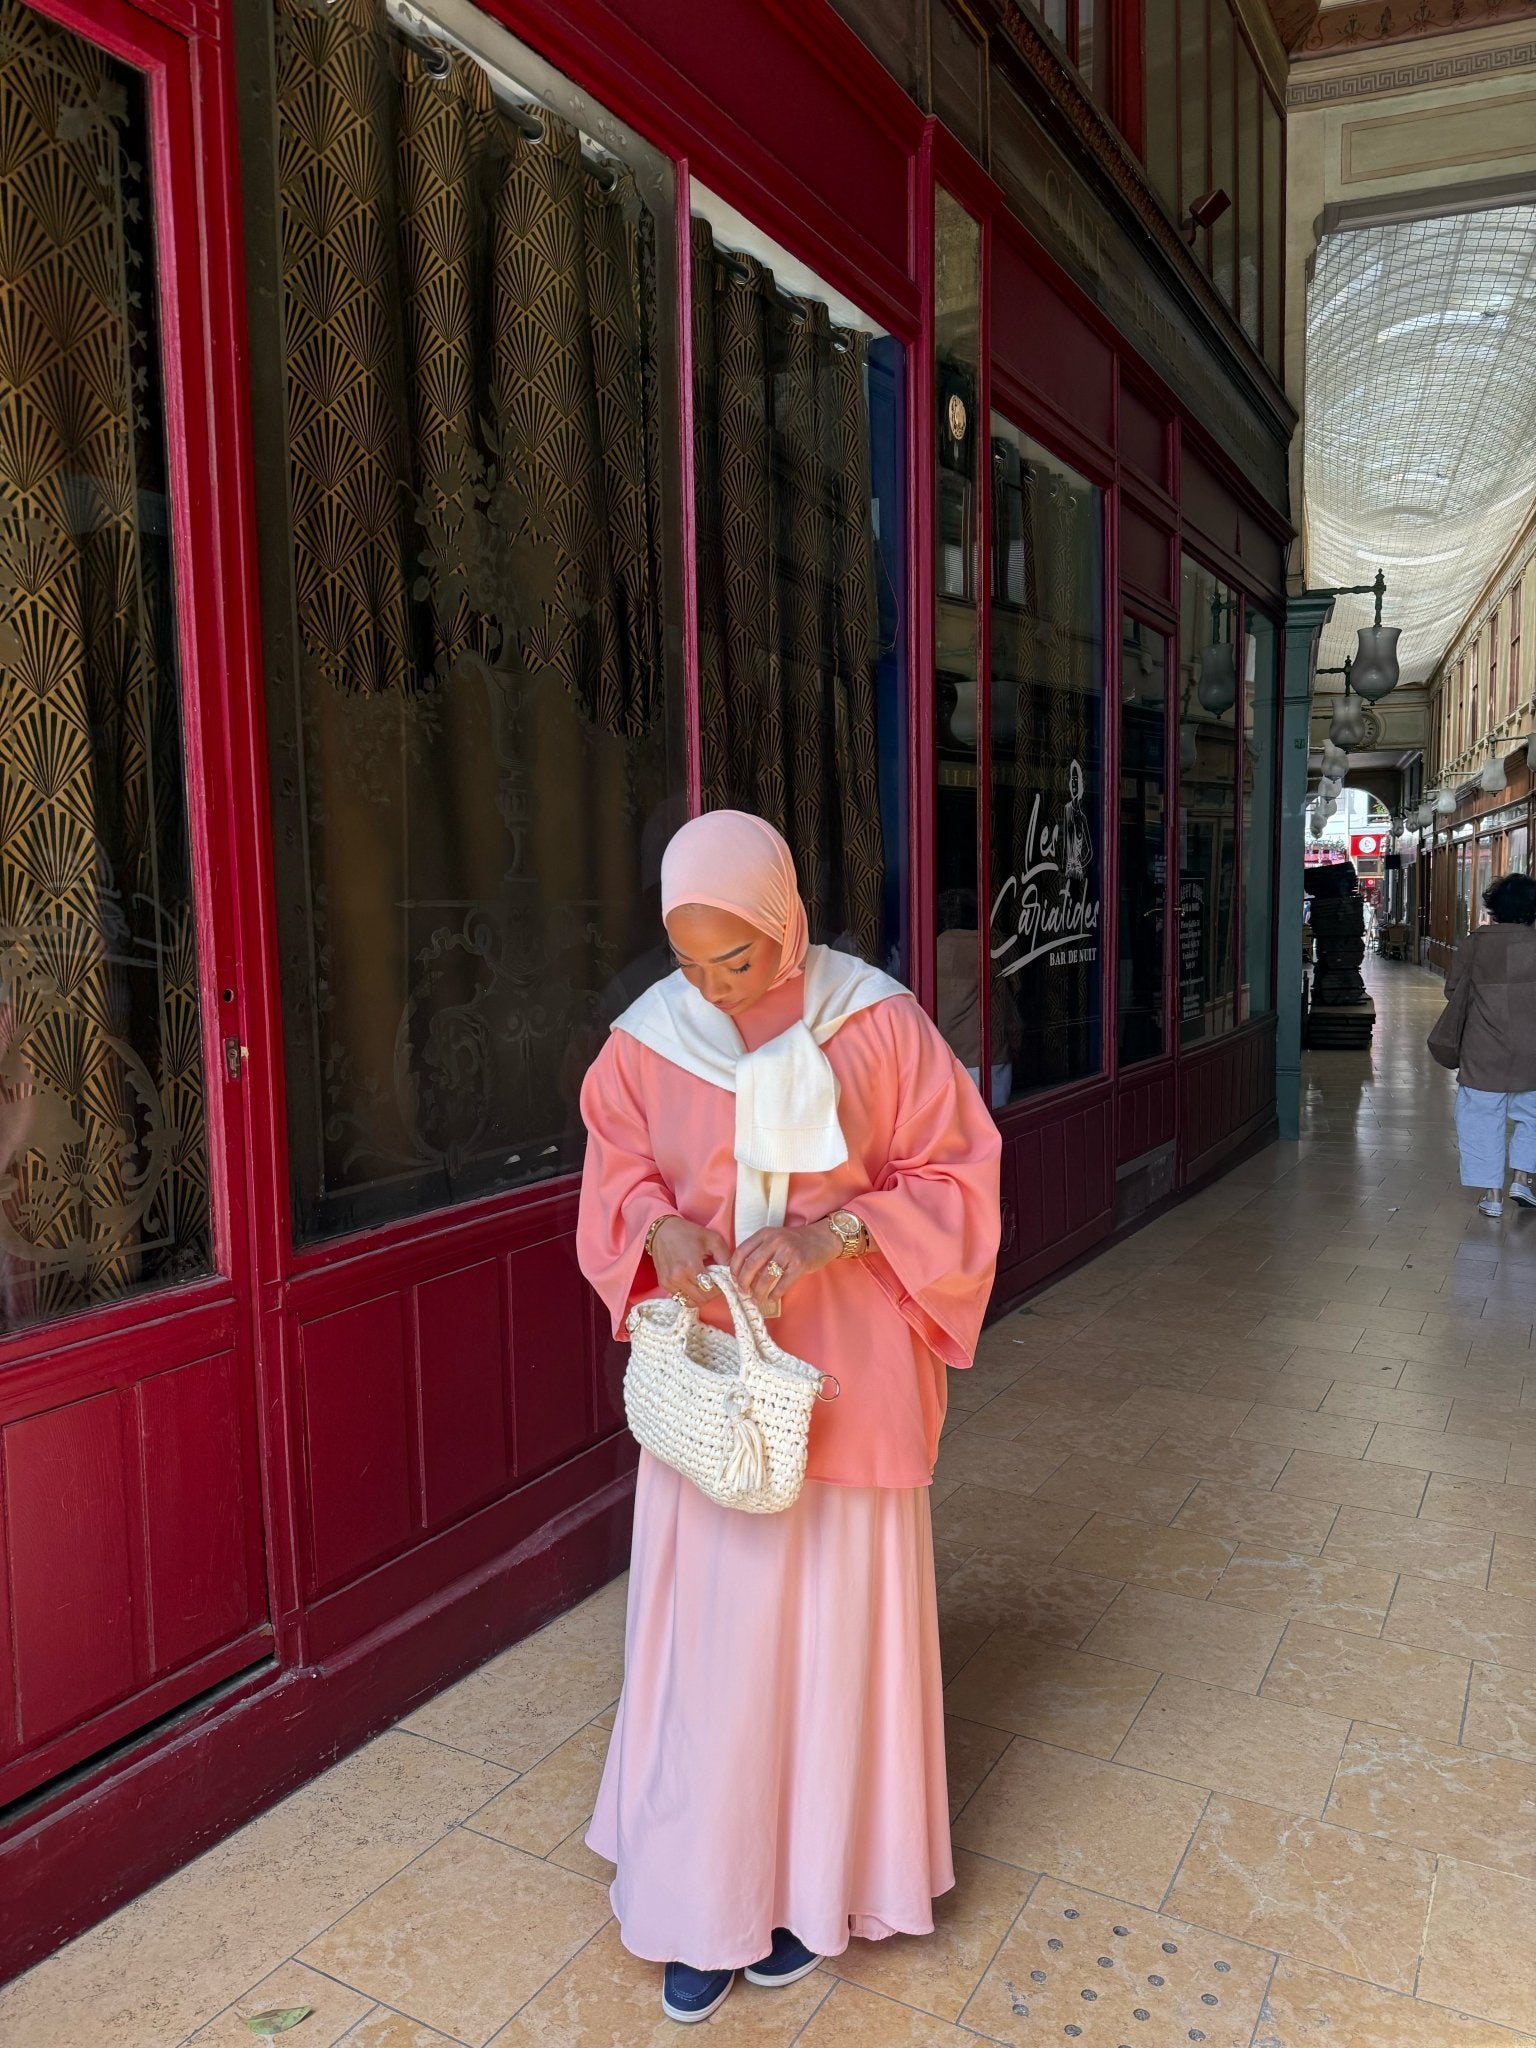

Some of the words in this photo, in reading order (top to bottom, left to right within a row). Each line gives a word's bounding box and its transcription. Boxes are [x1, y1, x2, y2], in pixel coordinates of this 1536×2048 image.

[1022, 793, 1059, 884] Les
[1050, 952, 1066, 966] BAR
[1068, 950, 1078, 964] DE
[1079, 948, 1097, 961] NUIT
